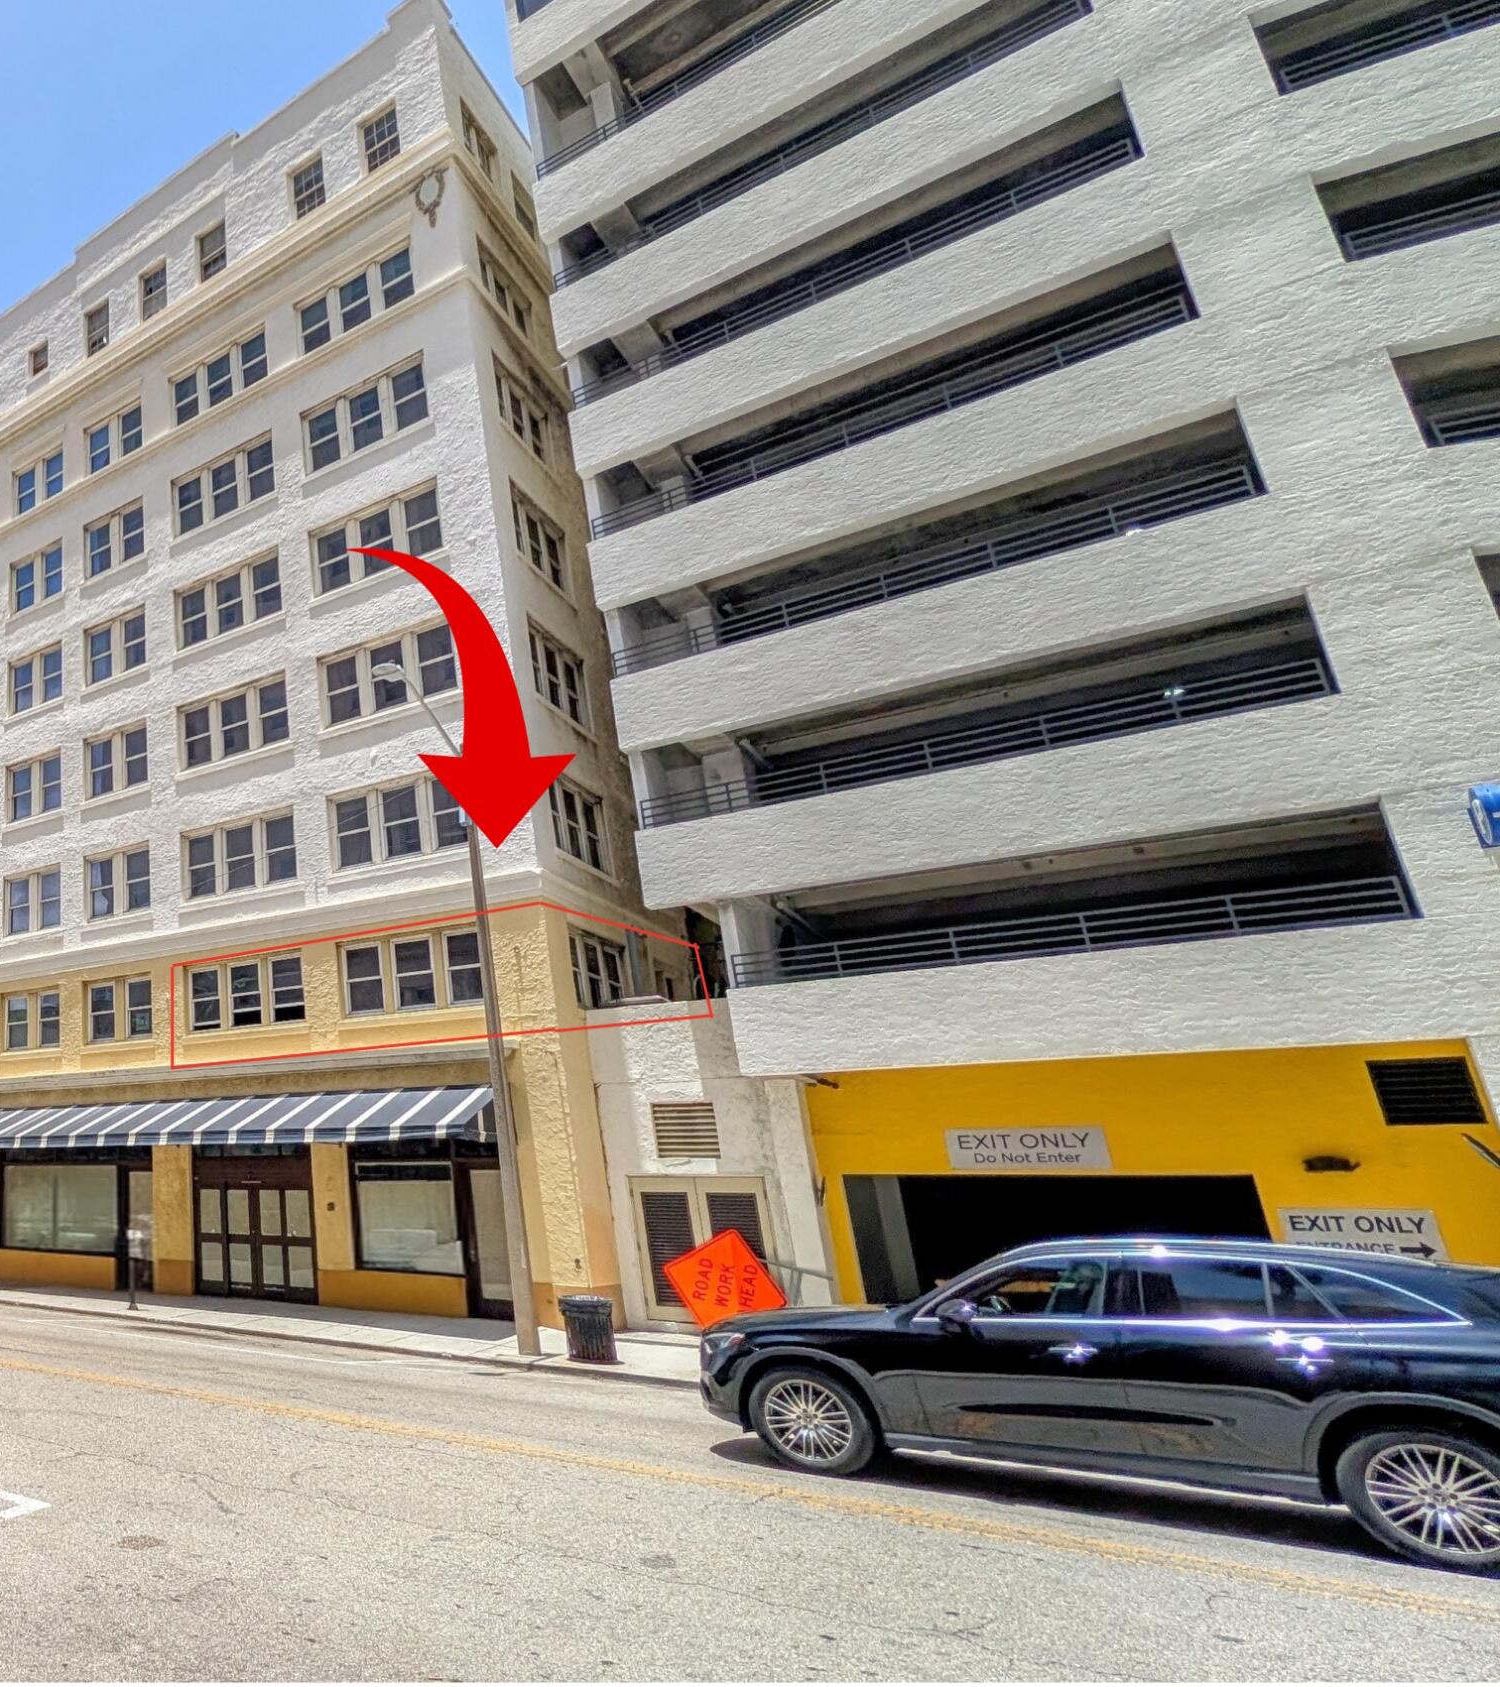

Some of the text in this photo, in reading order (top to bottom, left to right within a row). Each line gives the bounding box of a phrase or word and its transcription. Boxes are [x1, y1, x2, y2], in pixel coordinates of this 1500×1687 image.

[957, 1132, 1090, 1150] EXIT ONLY
[974, 1152, 1082, 1164] Do Not Enter
[1288, 1215, 1426, 1234] EXIT ONLY
[1296, 1241, 1395, 1254] RANCE
[692, 1258, 714, 1302] ROAD
[714, 1264, 736, 1308] WORK
[737, 1264, 758, 1313] HEAD
